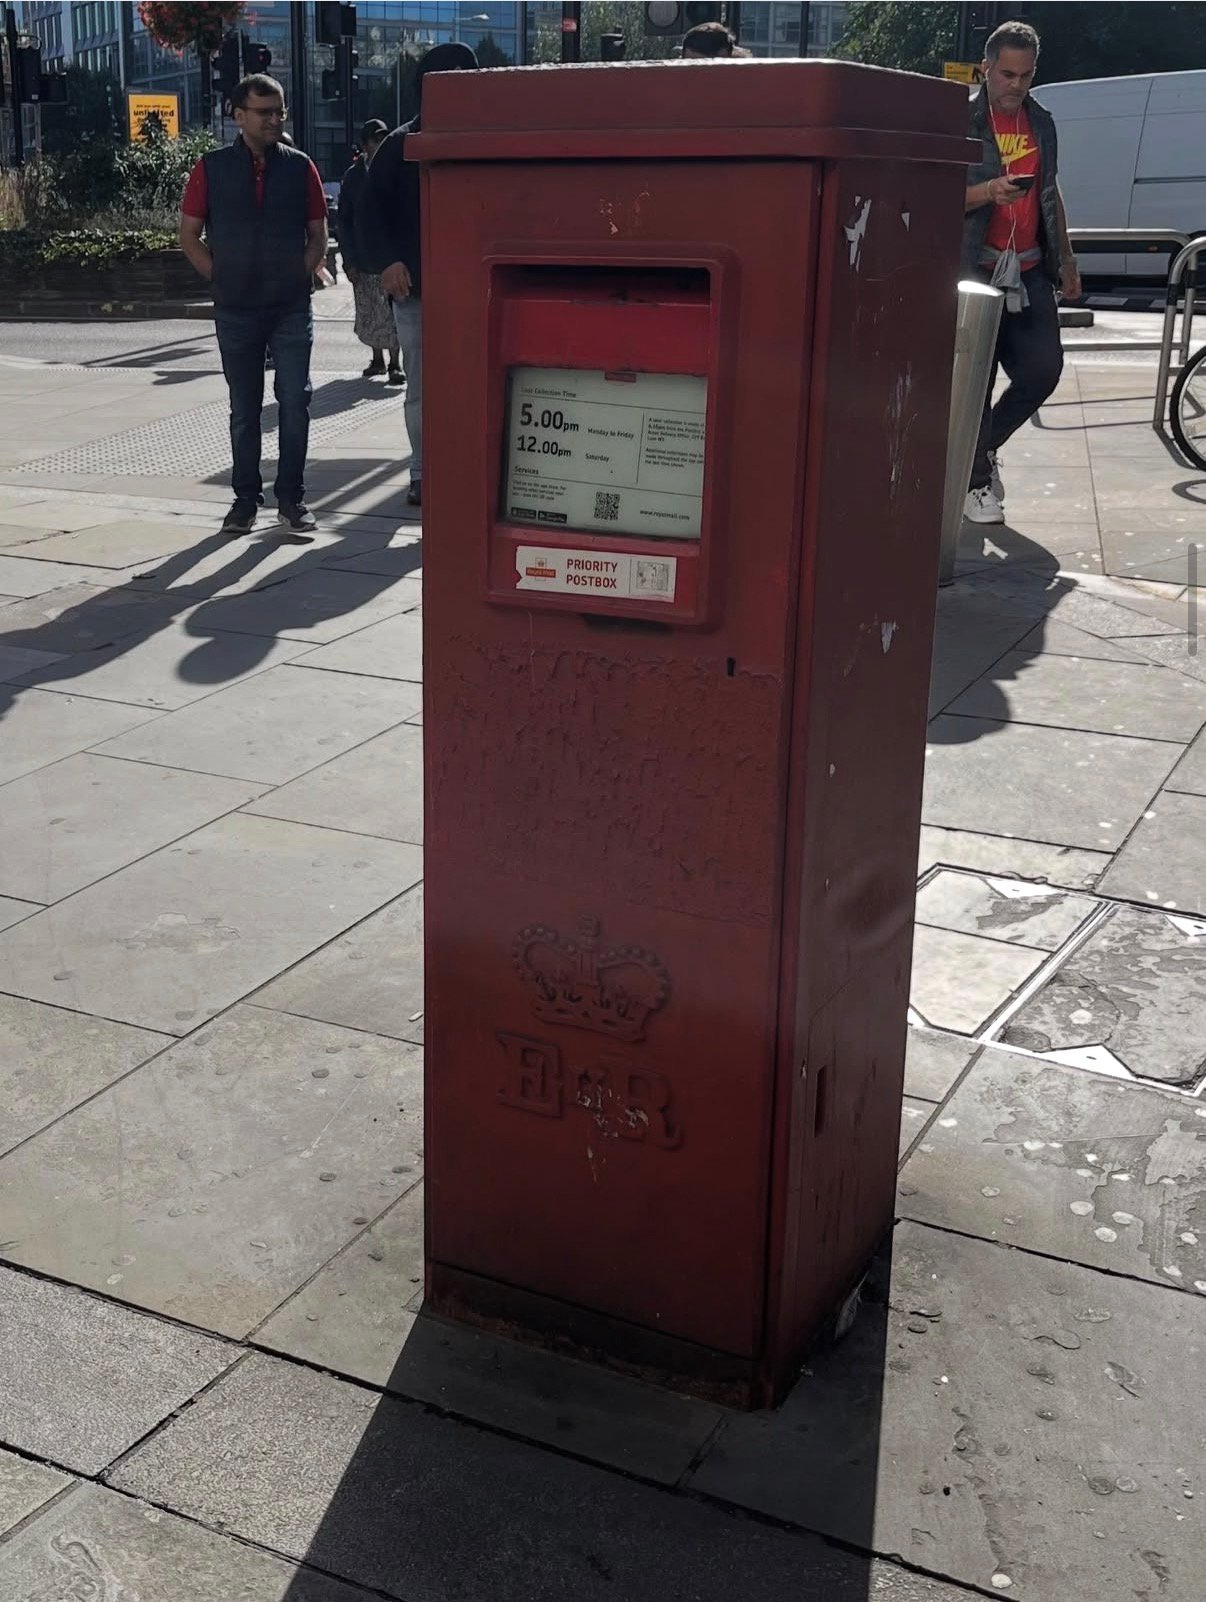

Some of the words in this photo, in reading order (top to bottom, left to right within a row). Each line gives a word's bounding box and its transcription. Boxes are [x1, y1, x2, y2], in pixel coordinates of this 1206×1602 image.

[994, 134, 1028, 155] NIKE
[563, 389, 577, 398] Time
[520, 403, 579, 432] 5.00pm
[588, 427, 609, 437] Monday
[617, 430, 634, 440] Friday
[517, 434, 571, 457] 12.00pm
[585, 453, 609, 463] Saturday
[515, 465, 539, 475] Services
[566, 558, 618, 573] PRIORITY
[566, 574, 617, 589] POSTBOX
